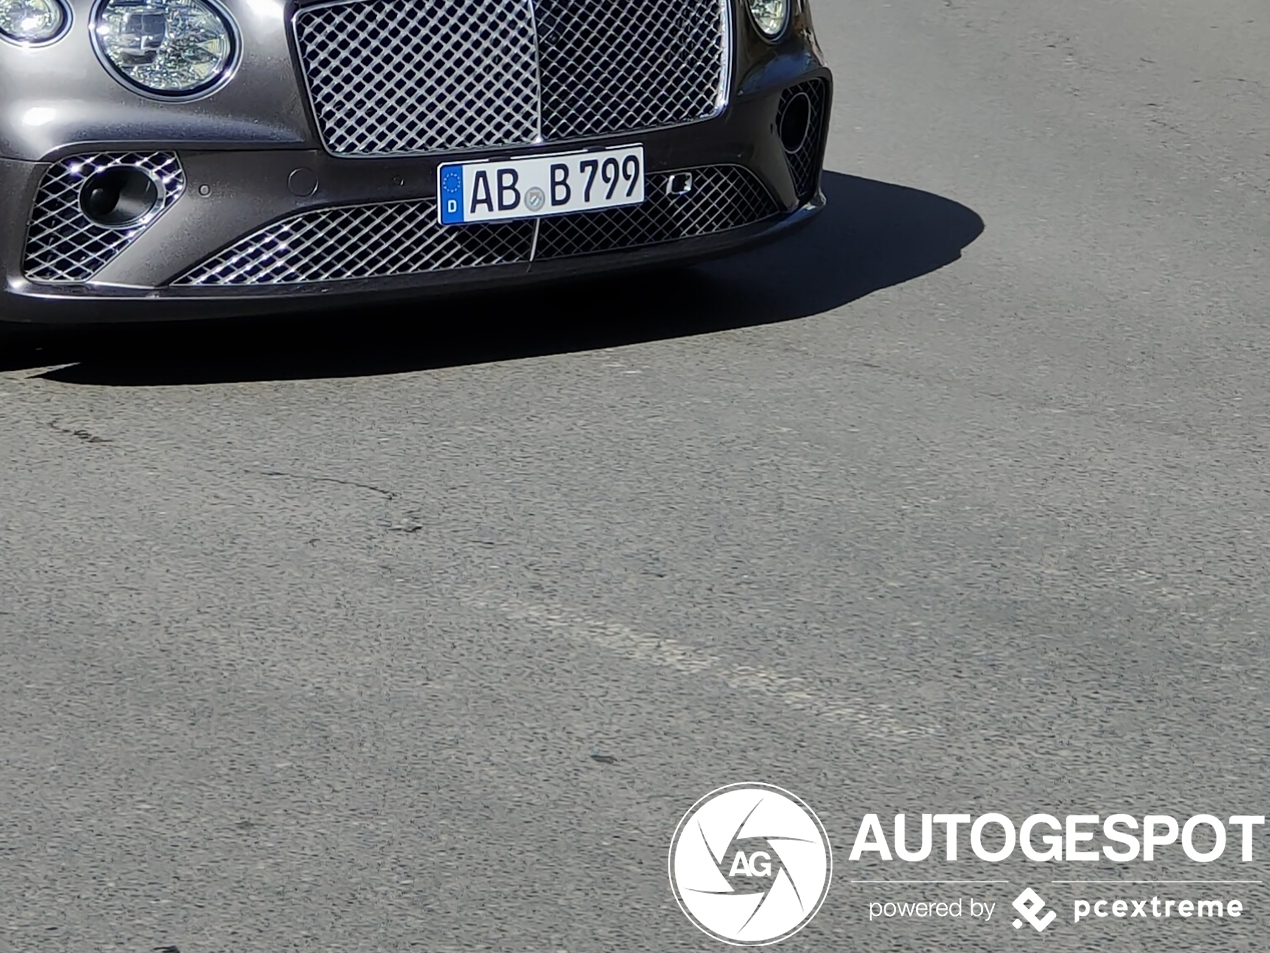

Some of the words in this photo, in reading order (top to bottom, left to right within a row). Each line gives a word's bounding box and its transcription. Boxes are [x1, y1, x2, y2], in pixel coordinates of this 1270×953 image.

[470, 168, 521, 214] AB
[550, 163, 571, 207] B
[579, 154, 640, 203] 799
[447, 199, 457, 213] D
